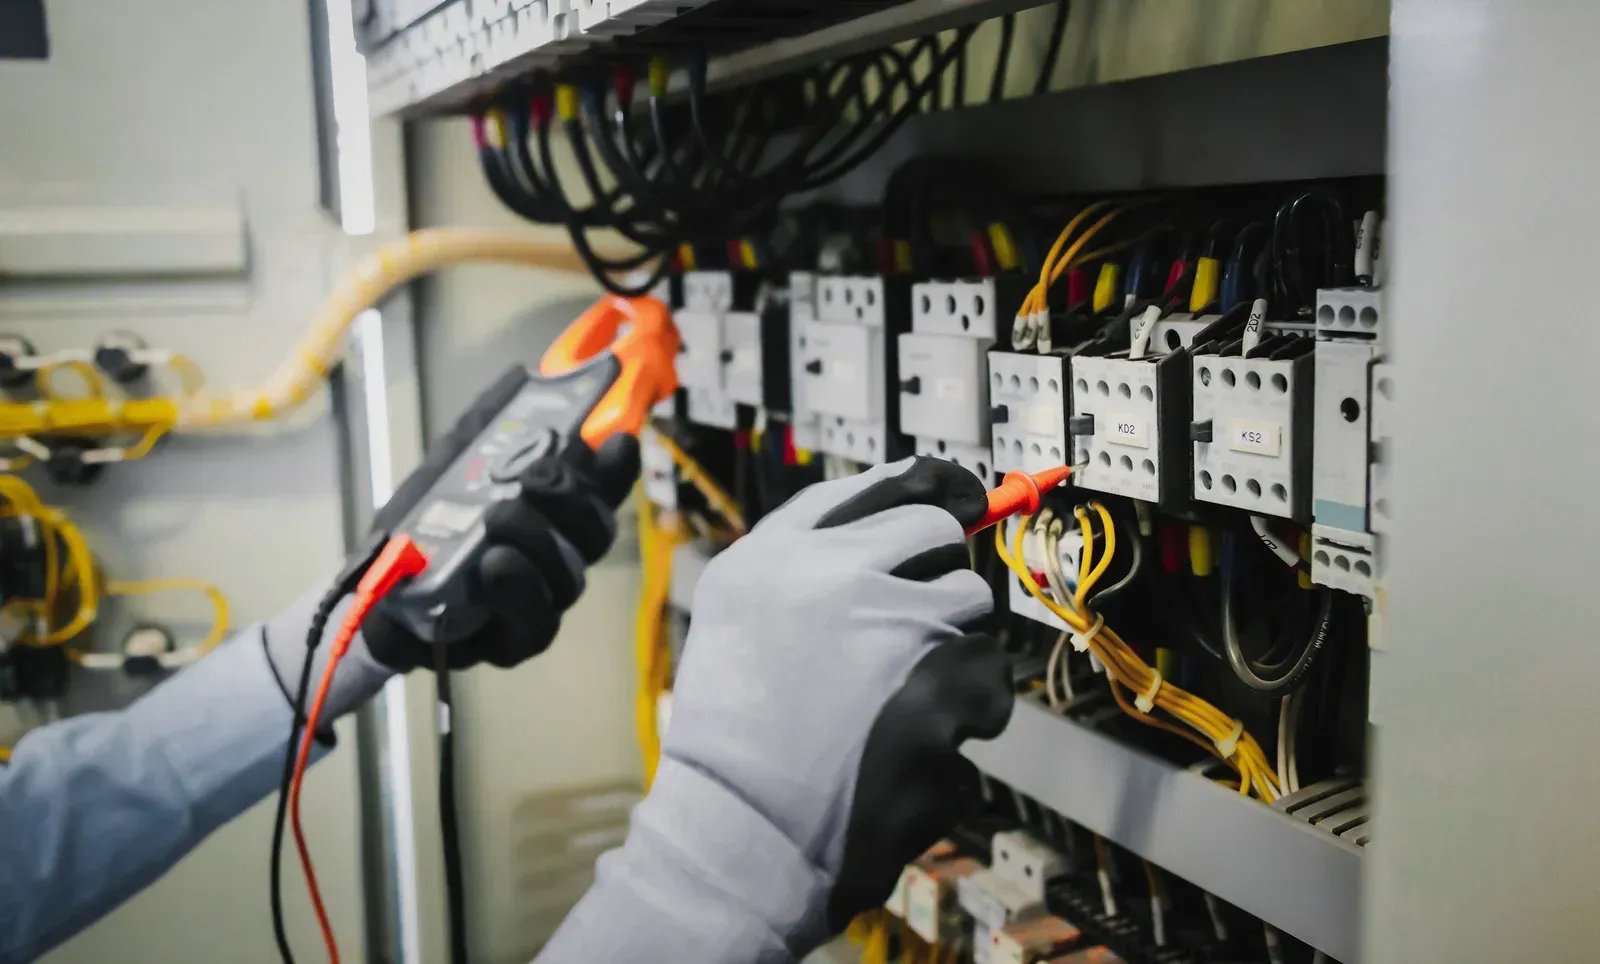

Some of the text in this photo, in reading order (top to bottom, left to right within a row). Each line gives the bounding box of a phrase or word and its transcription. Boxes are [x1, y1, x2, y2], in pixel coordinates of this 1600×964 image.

[1247, 313, 1261, 332] 2D2
[1118, 423, 1135, 435] KD2
[1241, 431, 1262, 444] KS2
